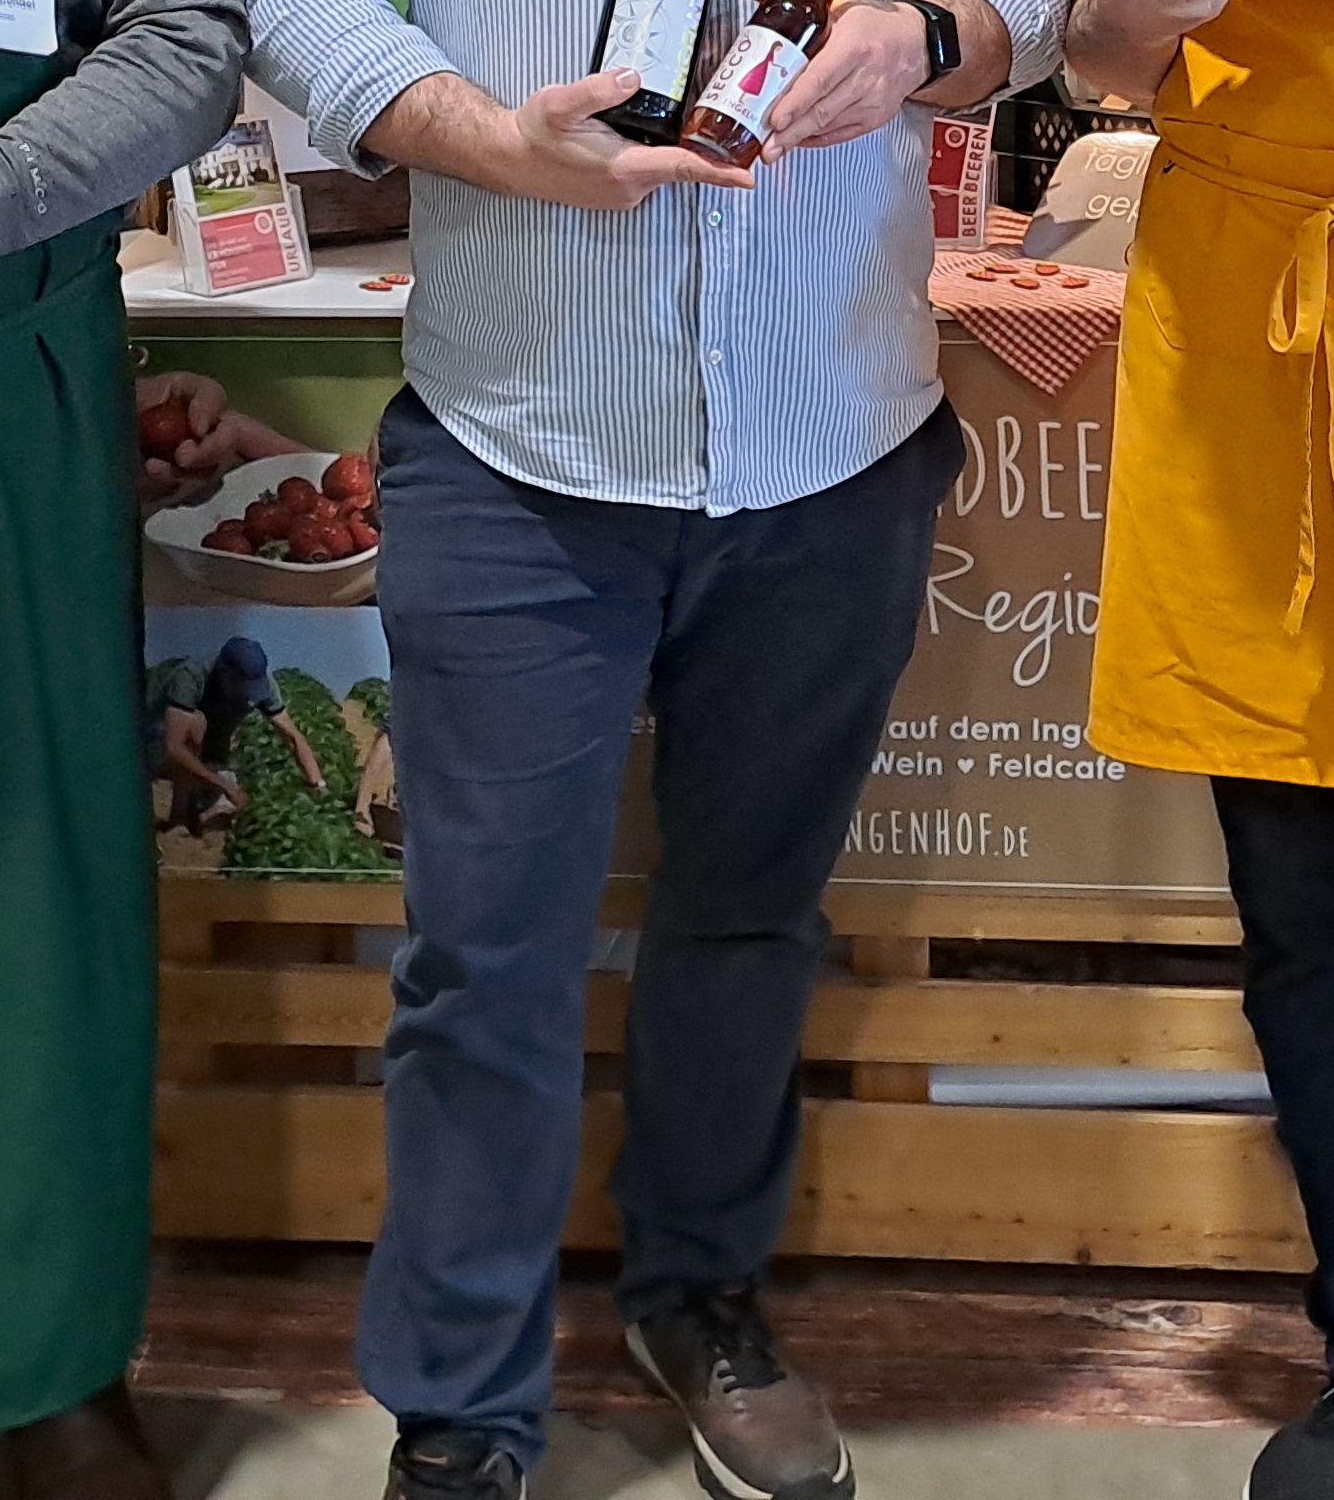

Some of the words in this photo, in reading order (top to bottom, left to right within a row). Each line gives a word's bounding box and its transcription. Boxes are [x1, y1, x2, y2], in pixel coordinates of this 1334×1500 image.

[706, 39, 752, 101] SECCO
[275, 206, 302, 273] URLAUB
[887, 715, 939, 741] auf
[949, 716, 1020, 742] dem
